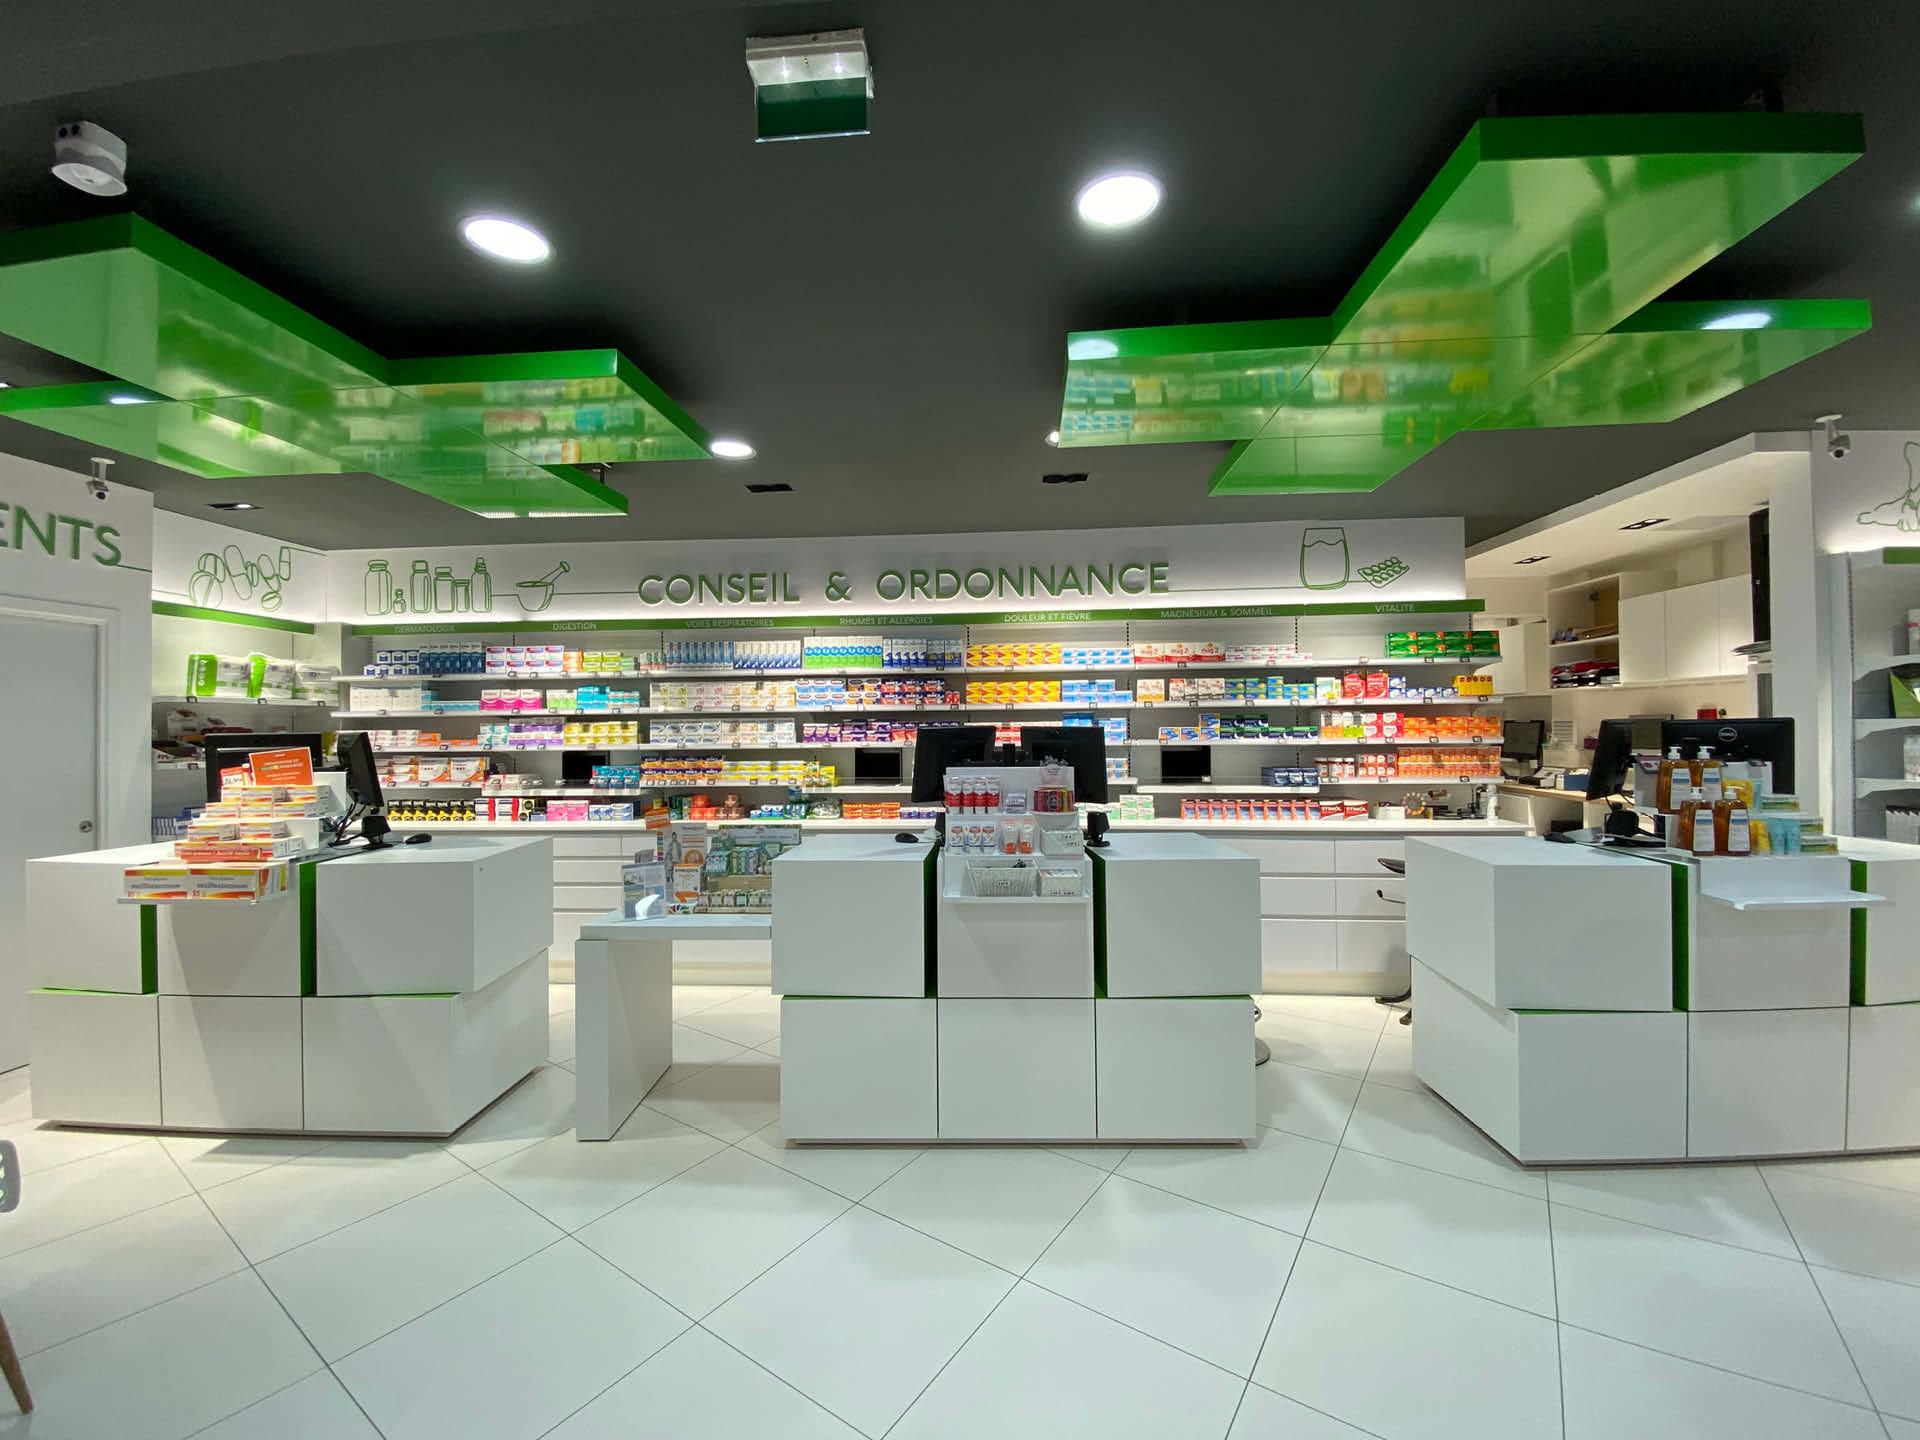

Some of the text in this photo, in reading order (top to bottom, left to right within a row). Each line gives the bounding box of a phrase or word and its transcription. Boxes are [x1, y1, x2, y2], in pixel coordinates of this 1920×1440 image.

[638, 562, 1169, 605] CONSEIL & ORDONNANCE
[1230, 605, 1273, 617] SOMMEIL
[839, 616, 874, 626] RHUMES
[889, 613, 933, 625] ALLERGIES
[1004, 613, 1046, 623] DOULEUR
[552, 622, 597, 631] DIGESTION
